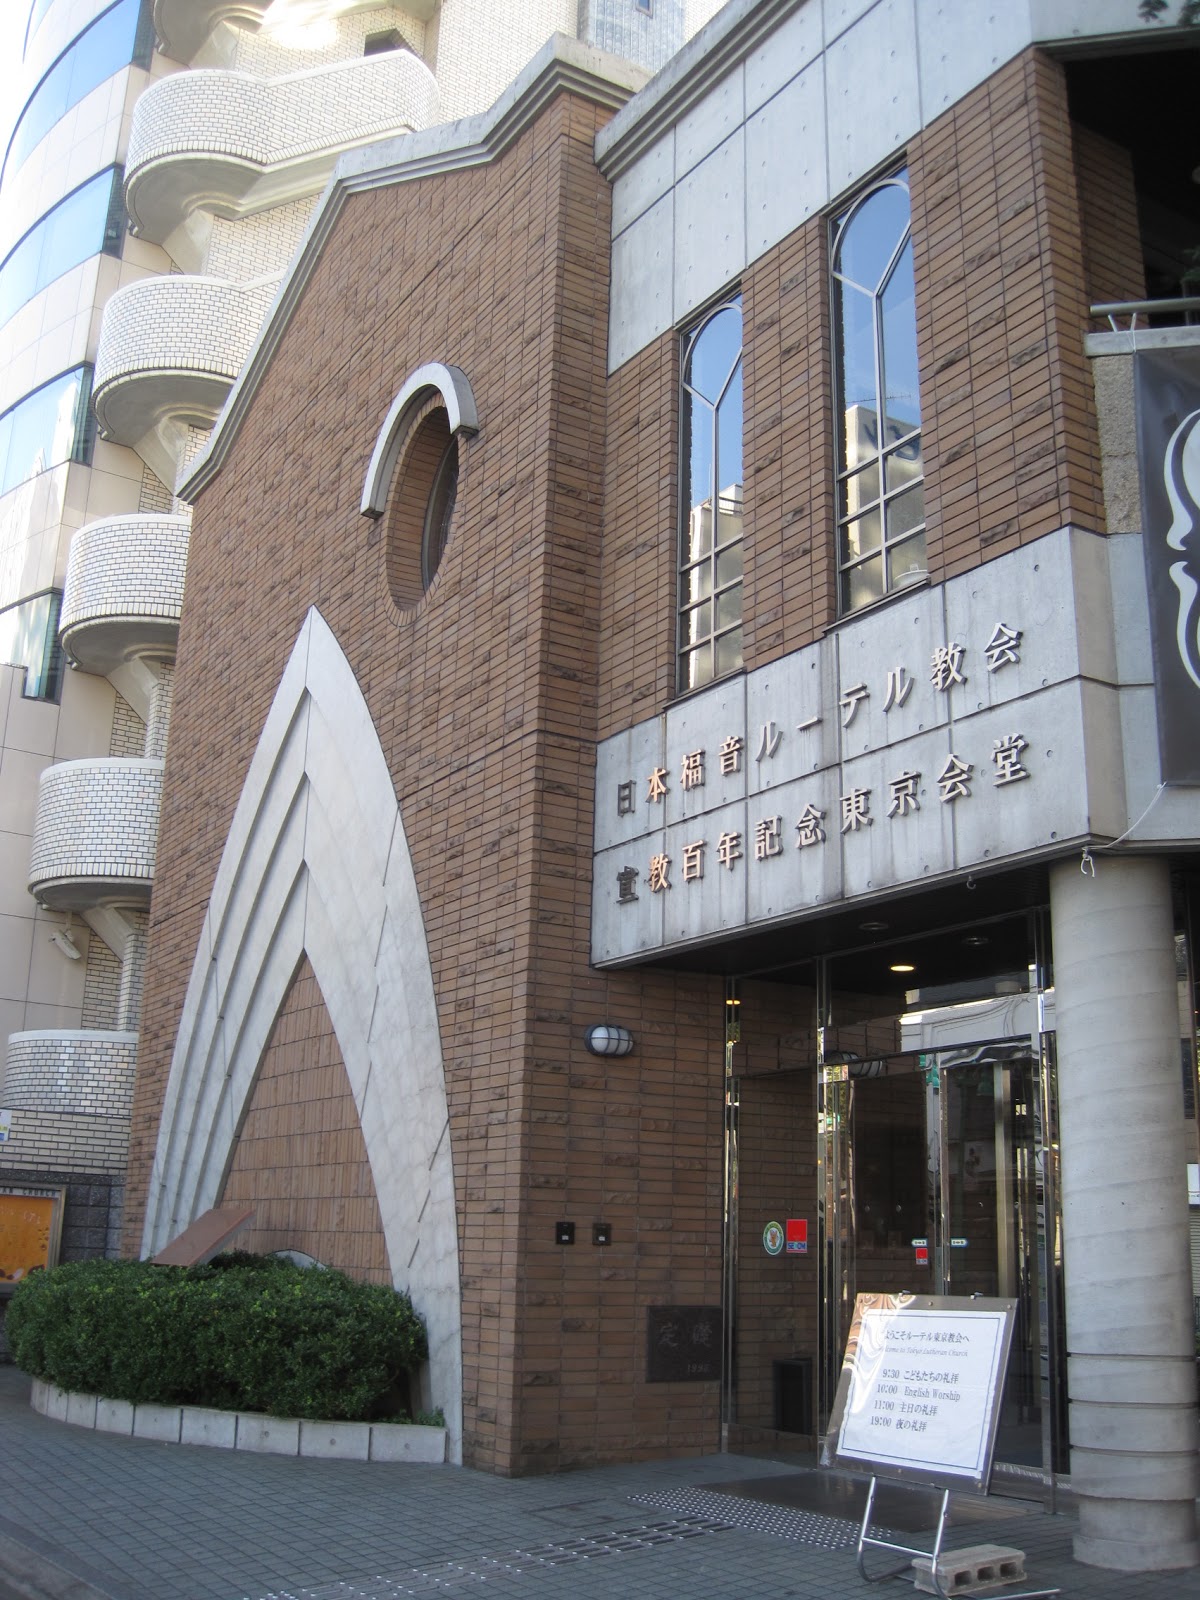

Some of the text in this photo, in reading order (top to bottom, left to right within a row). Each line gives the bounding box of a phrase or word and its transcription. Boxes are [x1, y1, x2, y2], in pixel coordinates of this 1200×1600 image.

[616, 621, 1023, 817] 日本福音ルーテル教会
[616, 732, 1032, 904] 宣教百年記念東京会堂
[882, 1369, 960, 1384] 9:30 こどもたちの礼拝
[877, 1383, 961, 1402] 10:00 English Worship
[874, 1399, 939, 1416] 11:00 主日の礼拝
[870, 1415, 928, 1432] 19:00 夜の礼拝
